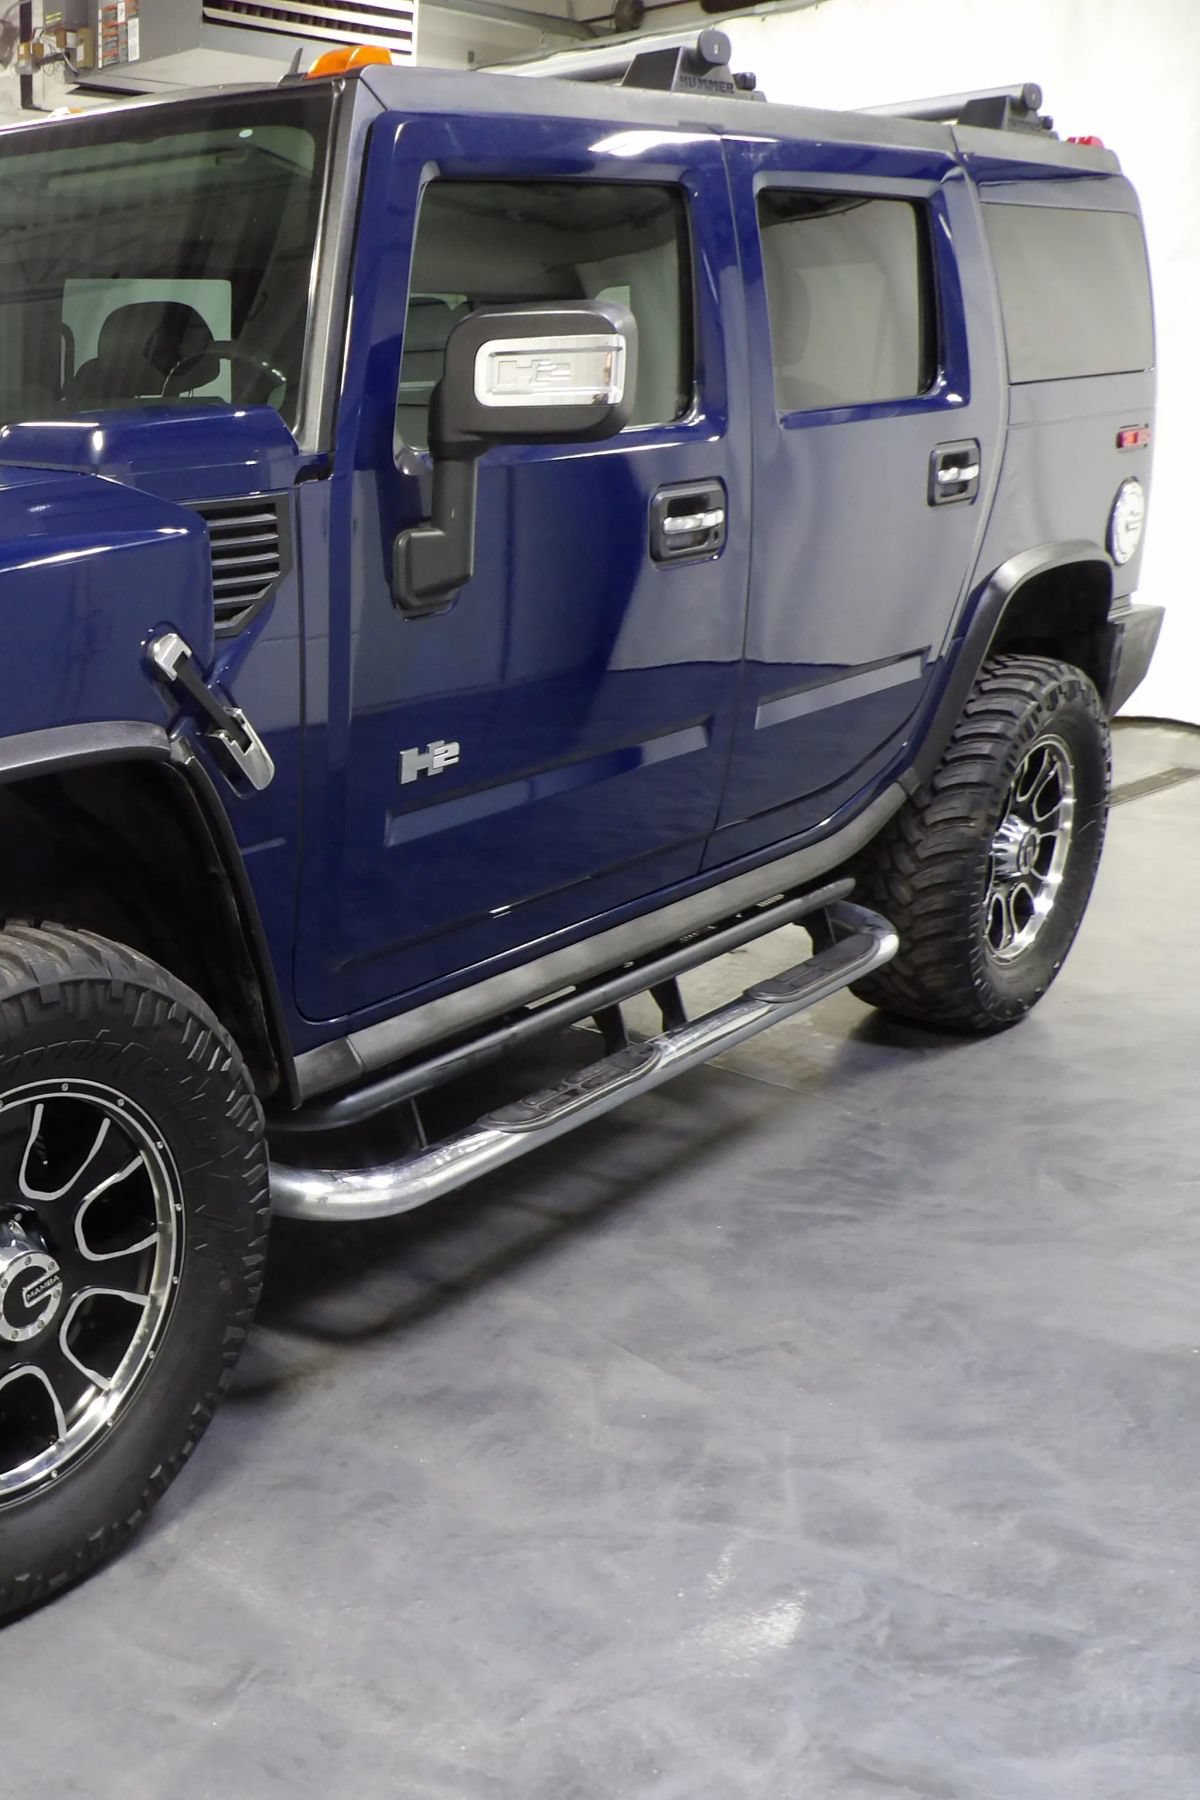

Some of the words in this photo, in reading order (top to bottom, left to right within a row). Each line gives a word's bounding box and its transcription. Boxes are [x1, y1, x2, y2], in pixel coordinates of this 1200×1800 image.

[679, 75, 735, 95] HUMMER
[399, 739, 460, 784] H2
[26, 1275, 60, 1300] MAMBA
